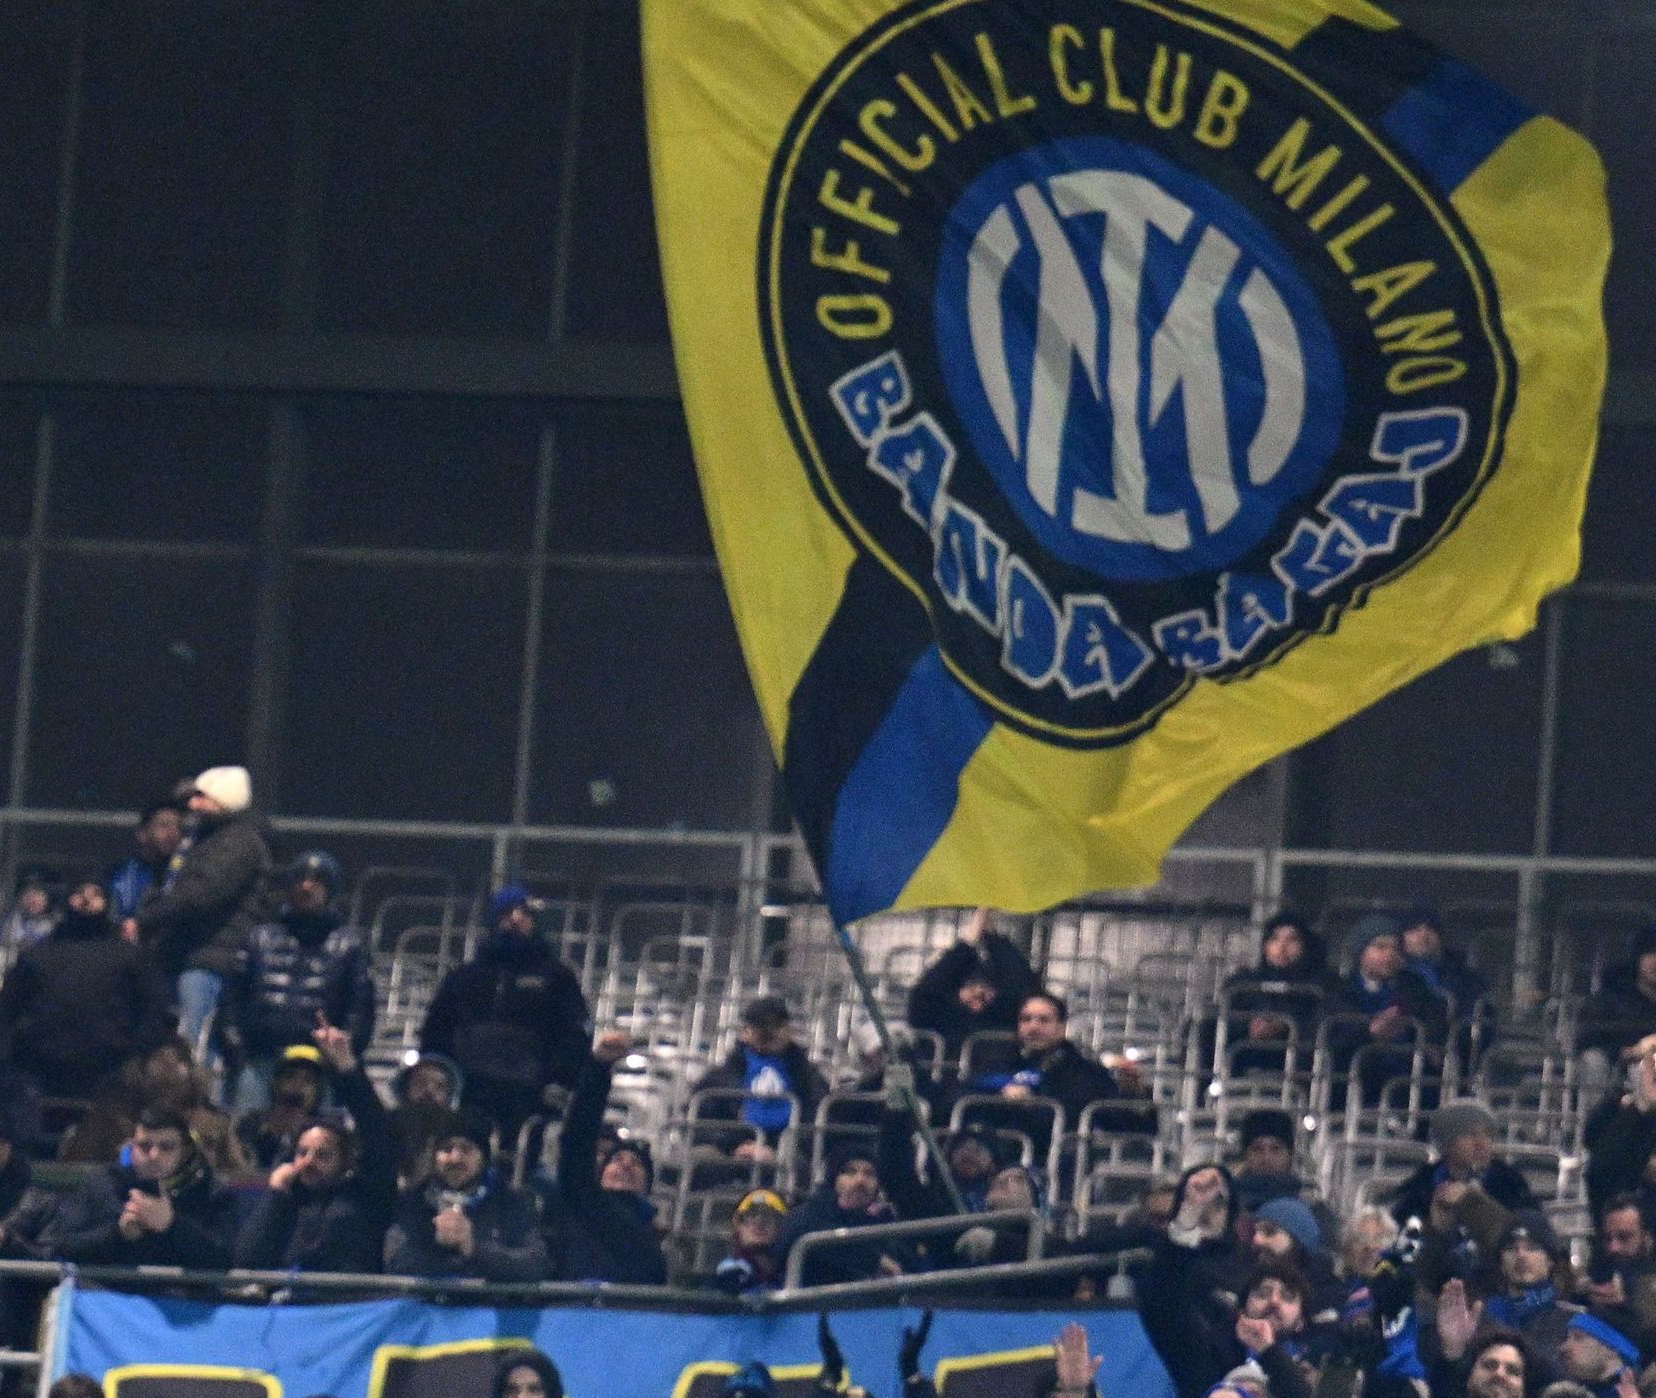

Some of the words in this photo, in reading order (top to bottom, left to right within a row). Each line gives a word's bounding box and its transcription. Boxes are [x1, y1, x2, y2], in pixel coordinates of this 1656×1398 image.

[812, 32, 1036, 340] OFFICIAL
[1049, 23, 1251, 149] CLUB
[1257, 118, 1468, 394] MILANO
[828, 348, 1156, 700] BANDA
